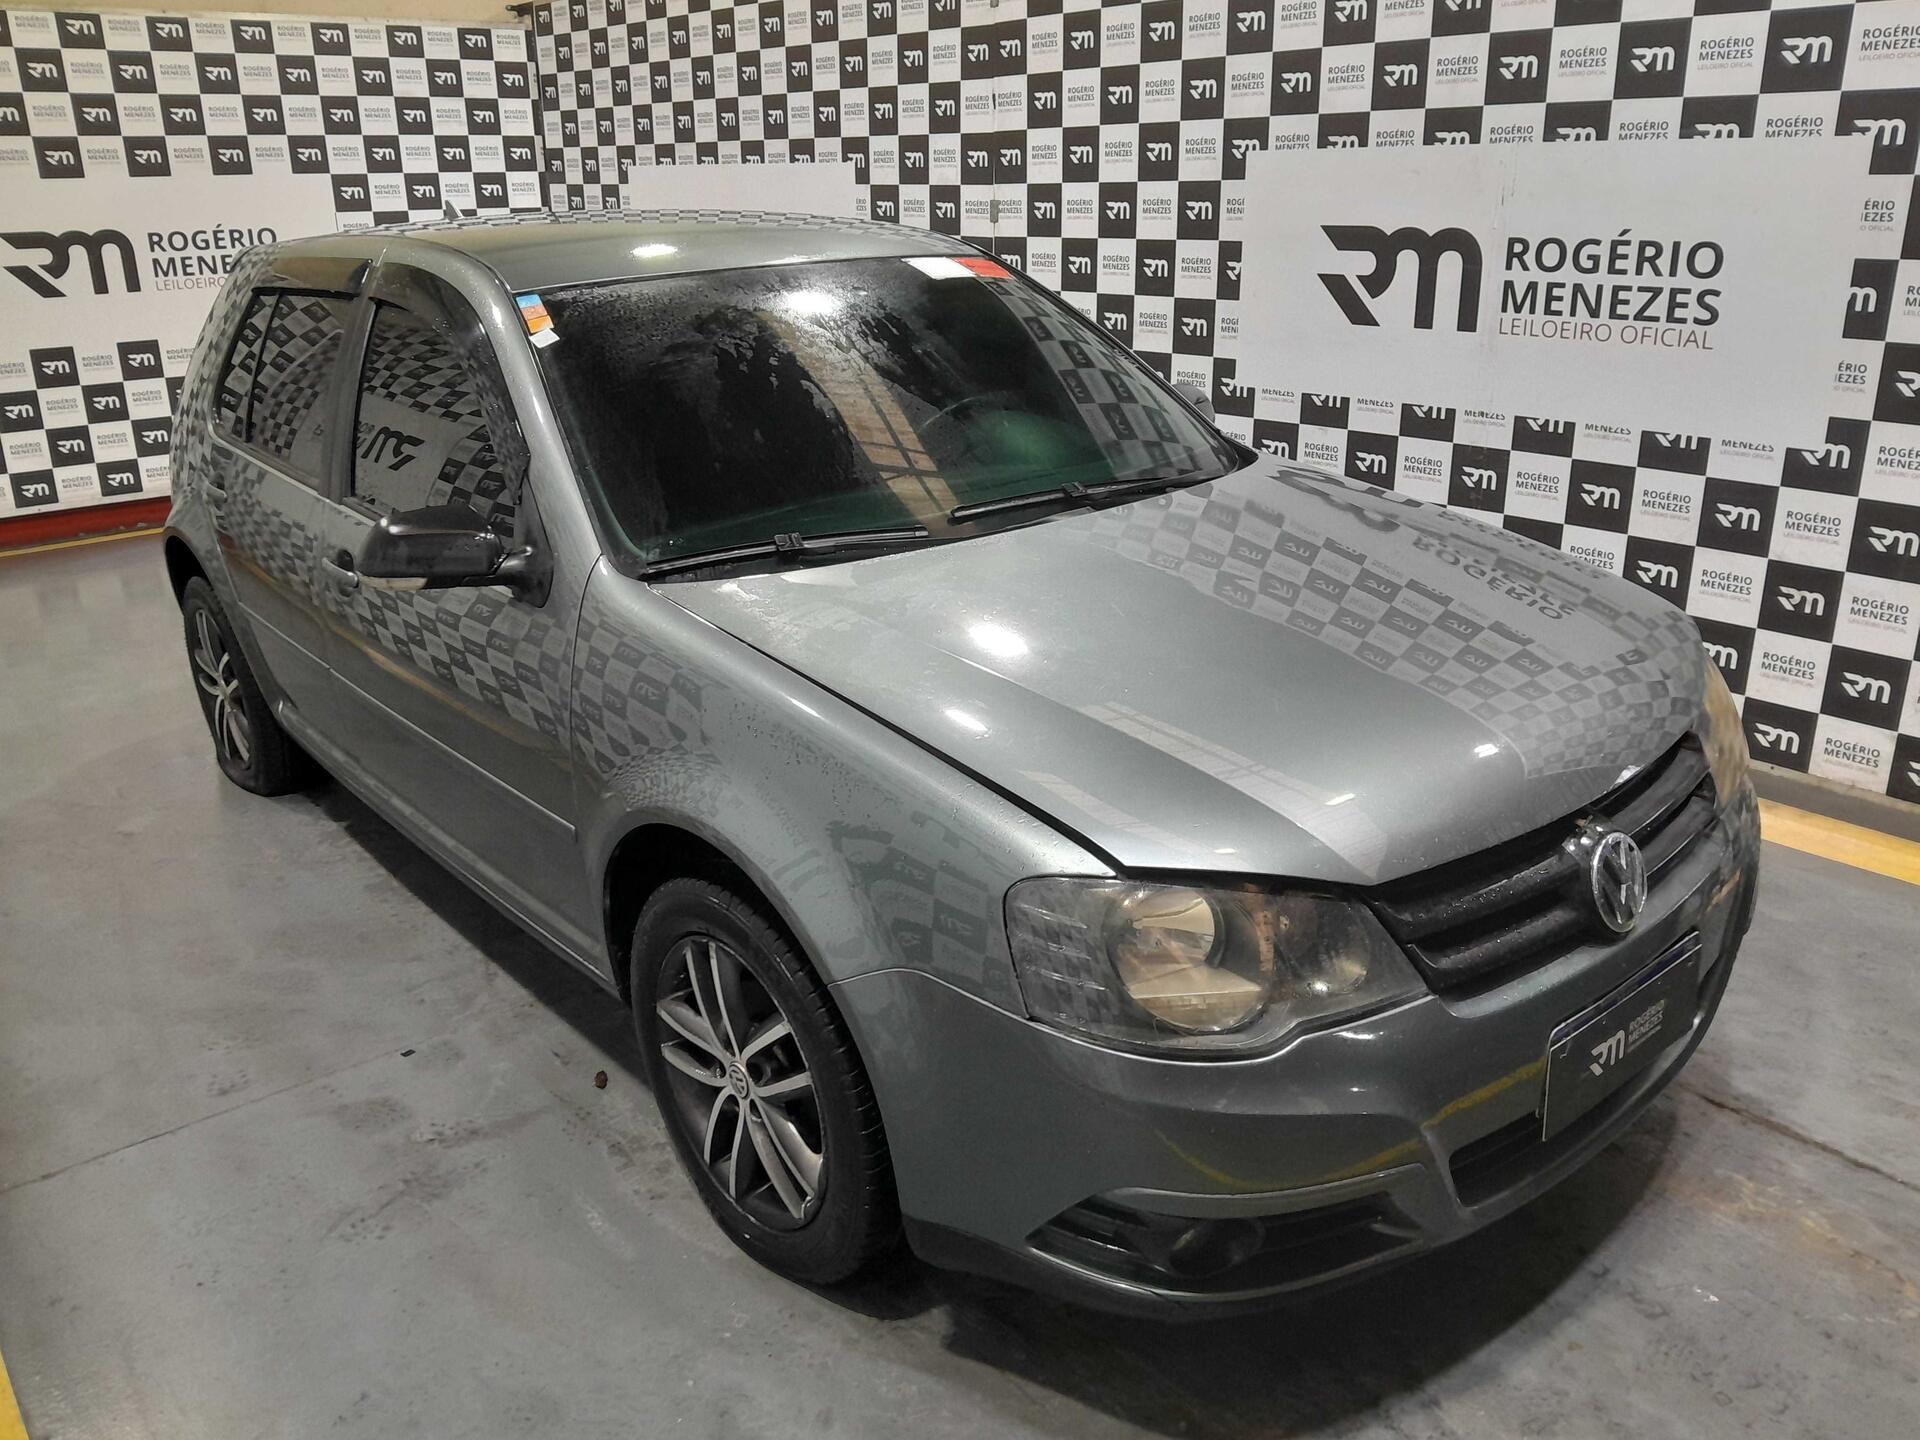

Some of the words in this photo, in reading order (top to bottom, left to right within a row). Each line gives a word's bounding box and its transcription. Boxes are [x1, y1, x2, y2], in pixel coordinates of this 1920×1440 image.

[1281, 1, 1317, 13] ROGÉRIO
[1189, 12, 1221, 23] ROGÉRIO
[1281, 10, 1317, 23] MENEZES
[1106, 22, 1135, 32] ROGÉRIO
[1189, 21, 1221, 32] MENEZES
[1032, 31, 1058, 41] ROGÉRIO
[1106, 31, 1135, 41] MENEZES
[1032, 40, 1058, 50] MENEZES
[1700, 36, 1754, 50] ROGÉRIO
[1560, 46, 1607, 59] ROGÉRIO
[1699, 48, 1753, 61] MENEZES
[1439, 55, 1479, 67] ROGÉRIO
[1559, 57, 1607, 69] MENEZES
[1328, 64, 1365, 75] ROGÉRIO
[1438, 66, 1478, 77] MENEZES
[1231, 72, 1264, 82] ROGÉRIO
[1328, 73, 1365, 84] MENEZES
[1145, 79, 1175, 88] ROGÉRIO
[1231, 81, 1264, 91] MENEZES
[1068, 85, 1095, 94] ROGÉRIO
[1145, 87, 1175, 97] MENEZES
[997, 91, 1022, 100] ROGÉRIO
[1067, 93, 1095, 102] MENEZES
[997, 99, 1022, 109] MENEZES
[1619, 120, 1669, 132] ROGÉRIO
[1766, 114, 1824, 128] ROGÉRIO
[1376, 129, 1415, 140] ROGÉRIO
[1490, 124, 1534, 136] ROGÉRIO
[1185, 137, 1216, 146] ROGÉRIO
[1275, 133, 1310, 143] ROGÉRIO
[1032, 144, 1057, 152] ROGÉRIO
[1105, 140, 1133, 149] ROGÉRIO
[1185, 146, 1216, 155] MENEZES
[965, 200, 989, 208] ROGÉRIO
[1142, 198, 1172, 206] ROGÉRIO
[1864, 199, 1895, 210] ÉRIO
[965, 207, 989, 215] MENEZES
[997, 206, 1022, 215] MENEZES
[1864, 212, 1894, 222] EZES
[148, 224, 278, 252] ROGÉRIO
[1031, 252, 1056, 260] ROGÉRIO
[1103, 254, 1130, 263] ROGÉRIO
[1504, 229, 1724, 280] ROGÉRIO
[151, 254, 235, 278] MENE
[1031, 260, 1056, 269] MENEZES
[1181, 257, 1211, 266] ROGÉRIO
[1102, 263, 1130, 272] MENEZES
[1181, 265, 1211, 274] MENEZES
[1501, 280, 1722, 327] MENEZES
[1139, 312, 1168, 321] ROGÉRIO
[1139, 320, 1167, 329] MENEZES
[1499, 318, 1612, 342] LEILOEIRO
[1620, 324, 1714, 350] OFICIAL
[1838, 360, 1867, 373] ÉRIO
[1176, 370, 1206, 380] ROGÉRIO
[1836, 374, 1866, 384] EZES
[1304, 442, 1339, 454] ROGÉRIO
[1304, 450, 1338, 462] MENEZES
[1404, 455, 1443, 468] ROGÉRIO
[1403, 464, 1442, 477] MENEZES
[1516, 471, 1560, 485] ROGÉRIO
[1516, 480, 1559, 495] MENEZES
[1643, 489, 1691, 504] ROGÉRIO
[1641, 499, 1690, 516] MENEZES
[1786, 510, 1841, 527] ROGÉRIO
[1785, 521, 1840, 537] MENEZES
[1570, 546, 1615, 561] ROGÉRIO
[1702, 569, 1753, 586] ROGÉRIO
[1700, 578, 1751, 596] MENEZES
[1852, 596, 1909, 615] ROGÉRIO
[1850, 606, 1908, 625] MENEZES
[1763, 651, 1816, 670] ROGÉRIO
[1761, 661, 1814, 680] MENEZES
[1825, 737, 1880, 758] ROGÉRIO
[1824, 747, 1879, 768] MENEZES
